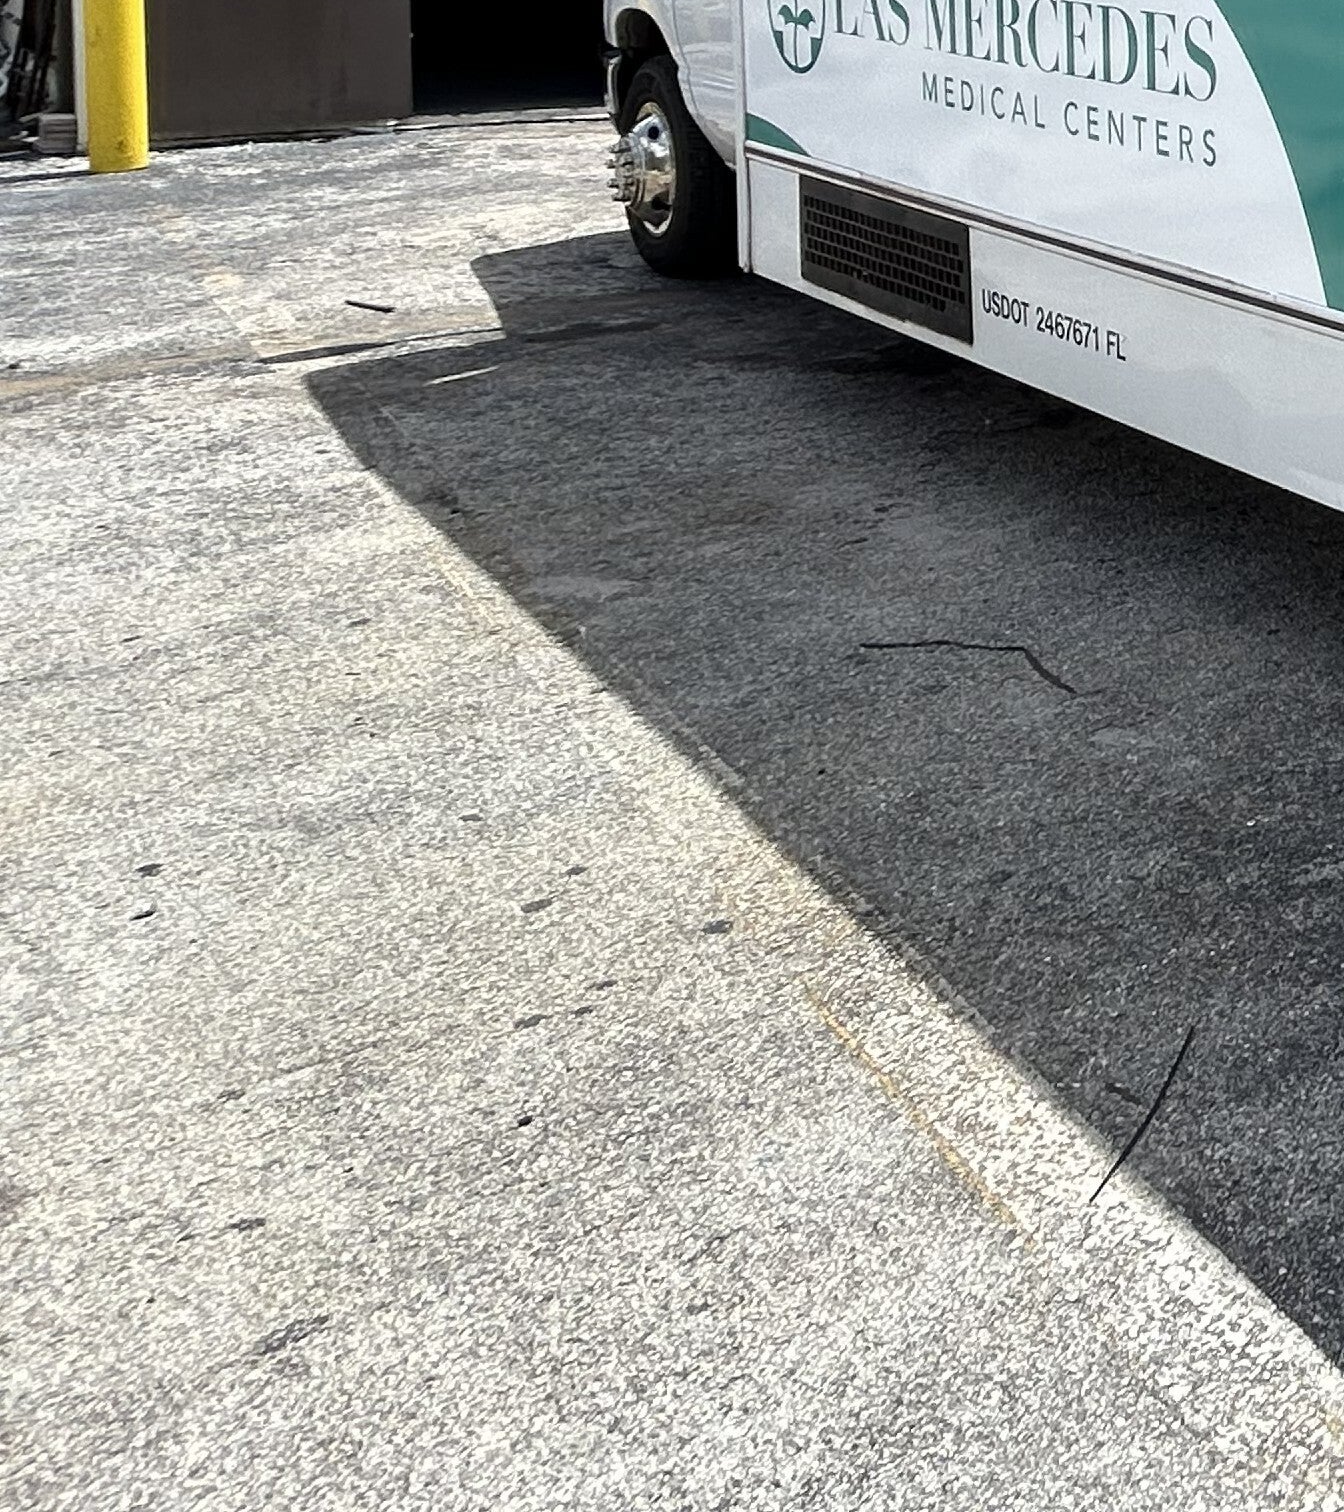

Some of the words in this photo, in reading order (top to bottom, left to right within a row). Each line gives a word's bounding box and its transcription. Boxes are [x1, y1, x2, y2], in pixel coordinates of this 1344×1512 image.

[922, 71, 1046, 129] MEDICAL
[1064, 101, 1217, 167] CENTERS
[982, 288, 1029, 327] USDOT
[1036, 307, 1099, 351] 2467671
[1106, 330, 1126, 361] FL
